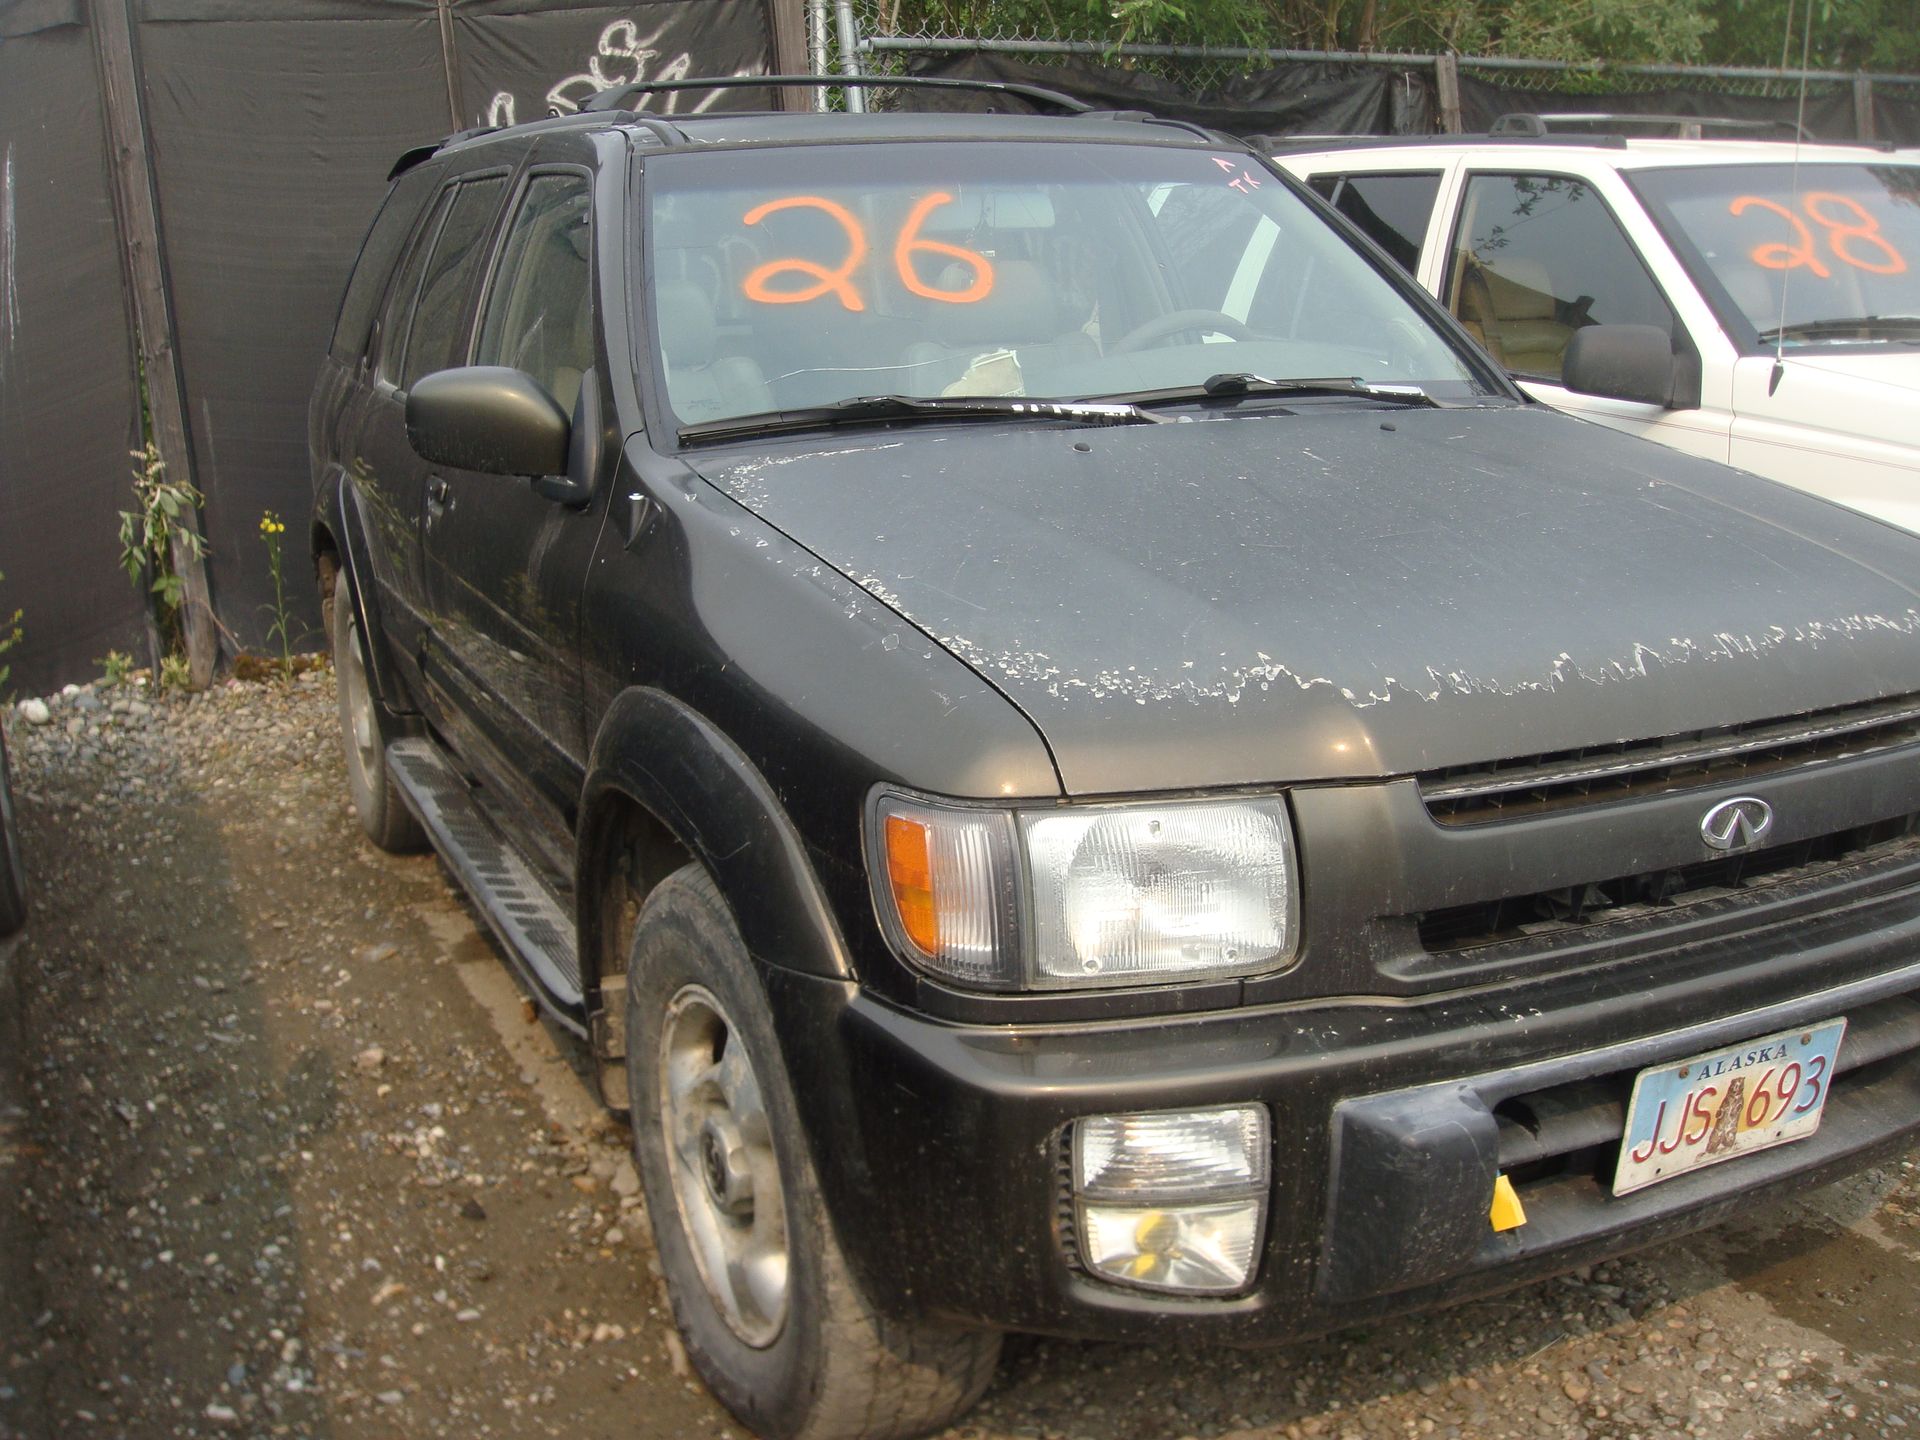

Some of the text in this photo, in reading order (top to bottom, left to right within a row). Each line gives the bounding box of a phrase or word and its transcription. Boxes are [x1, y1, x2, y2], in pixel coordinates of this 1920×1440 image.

[743, 193, 995, 312] 26
[1729, 191, 1907, 279] 28
[1696, 1043, 1788, 1081] ALASKA
